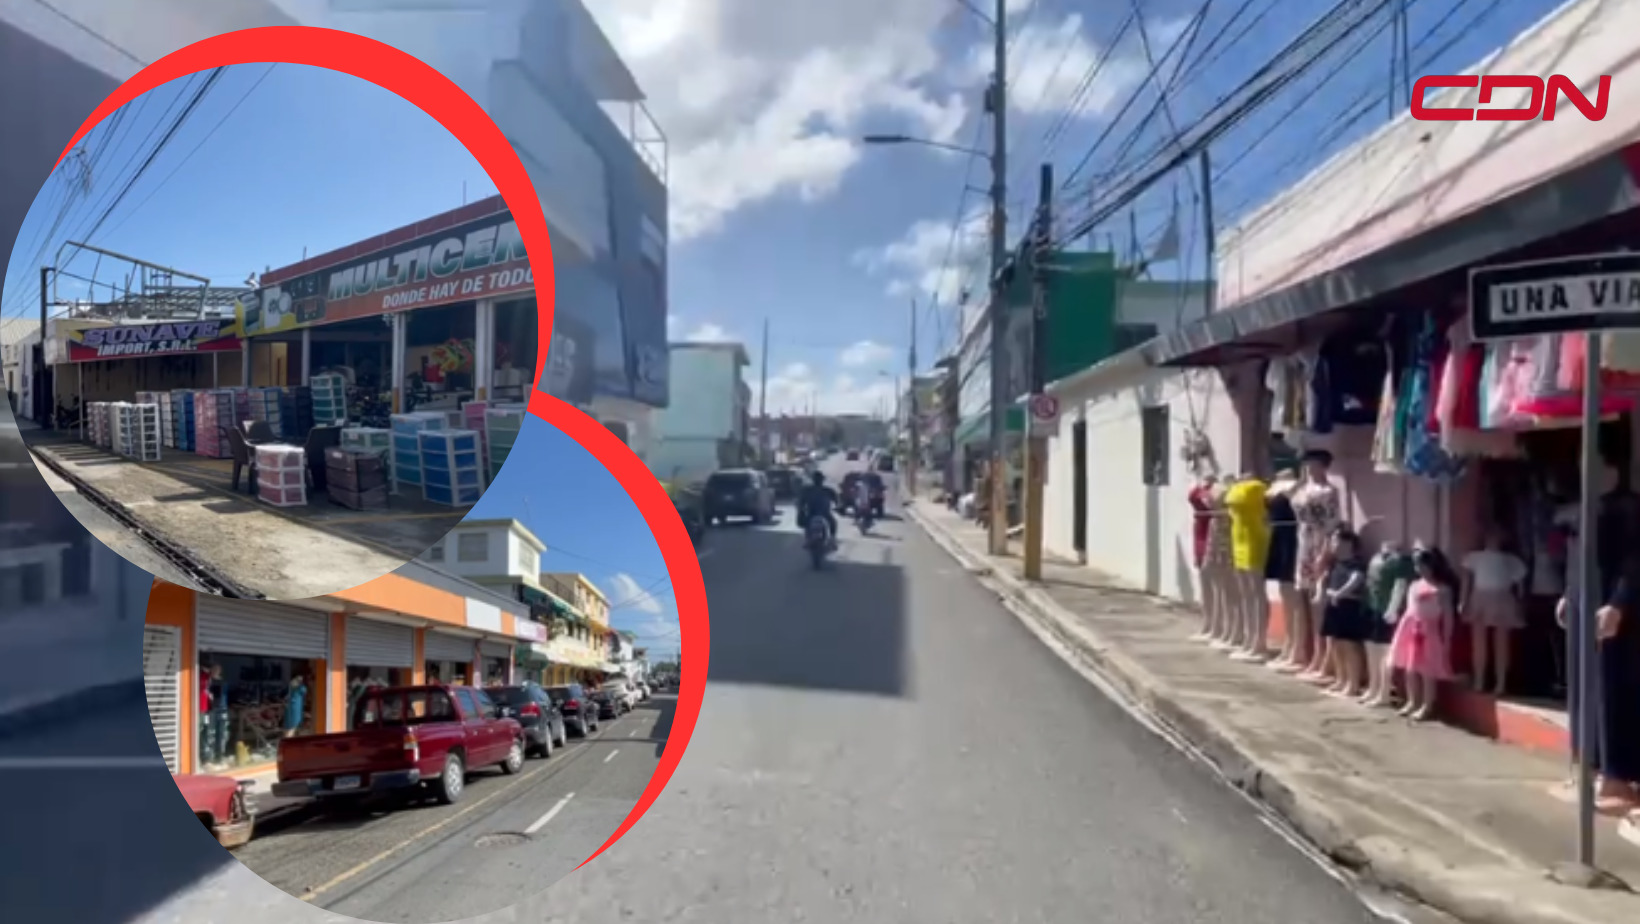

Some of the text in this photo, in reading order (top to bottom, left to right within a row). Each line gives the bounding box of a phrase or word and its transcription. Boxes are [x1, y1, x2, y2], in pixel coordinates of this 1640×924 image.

[382, 286, 426, 309] DONDE
[429, 279, 460, 300] HAY
[461, 273, 484, 294] DE
[1502, 278, 1640, 315] UNA VIA
[82, 321, 221, 346] SUNAVE
